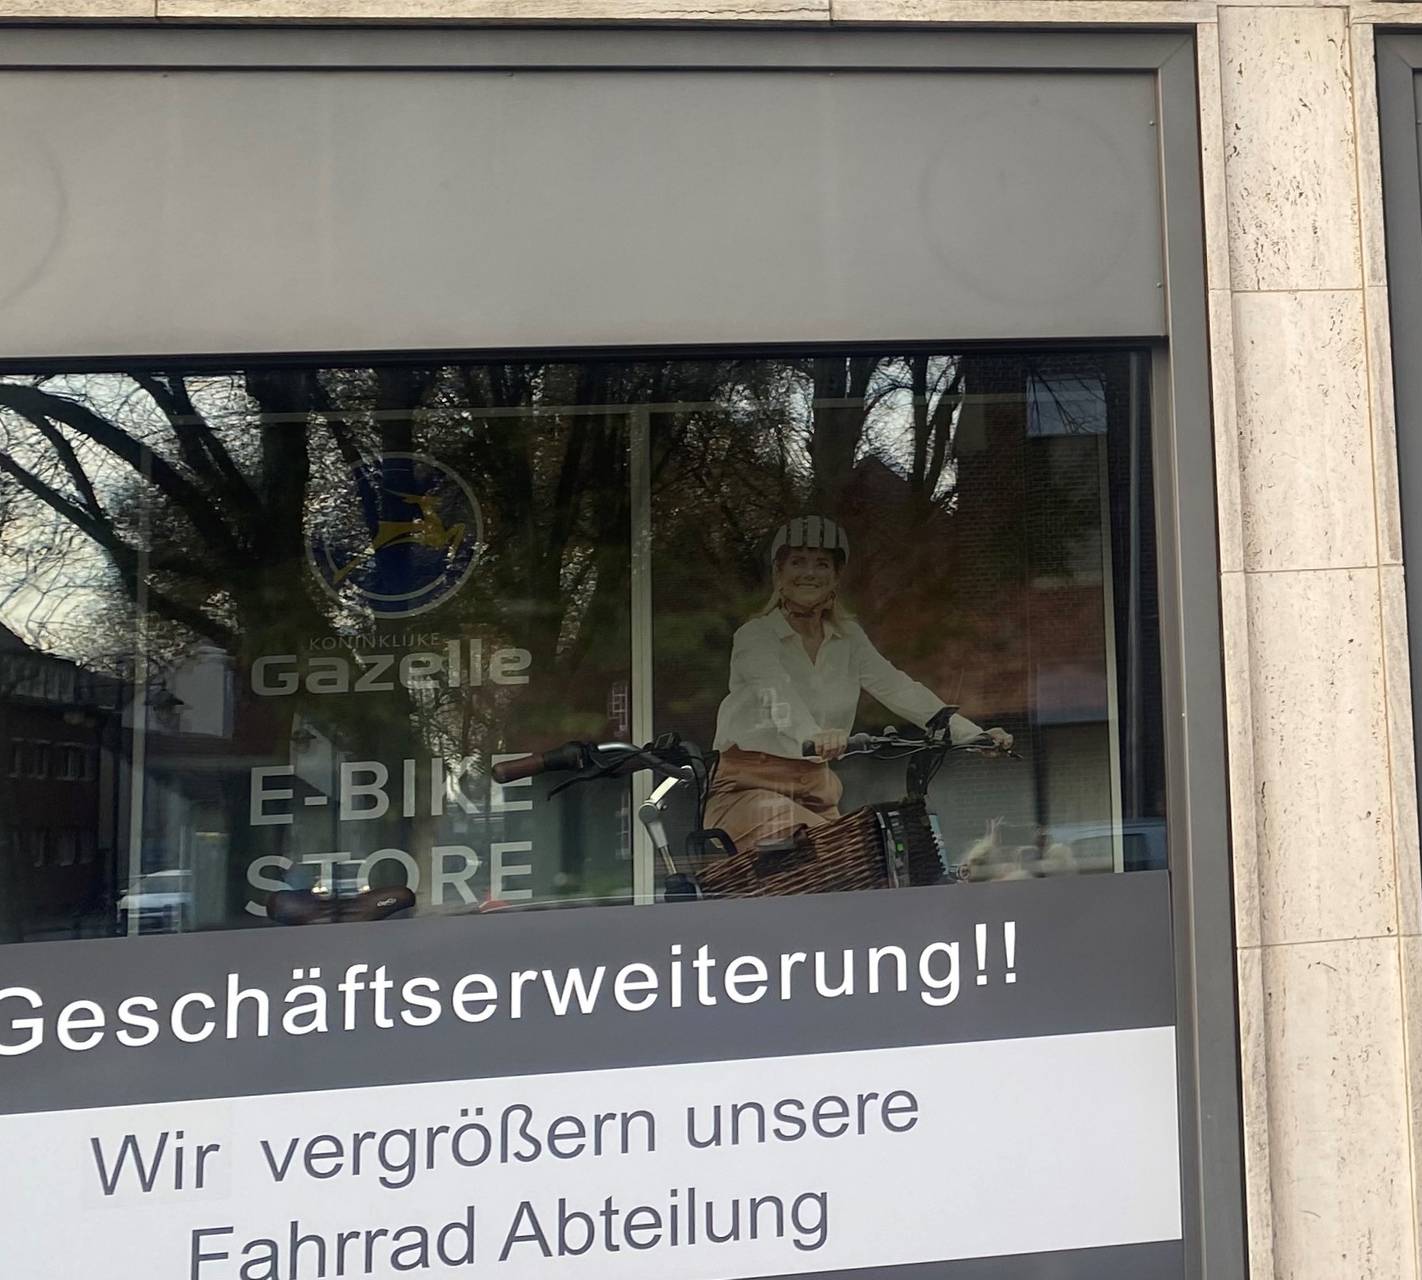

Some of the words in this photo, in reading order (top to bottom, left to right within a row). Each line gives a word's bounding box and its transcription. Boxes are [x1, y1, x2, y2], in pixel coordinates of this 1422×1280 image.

[250, 639, 533, 697] Gazelle
[309, 632, 441, 651] KONINKLIJKE
[249, 752, 534, 826] E-BIKE
[244, 840, 534, 919] STORE
[0, 921, 1017, 1057] Geschäftserweiterung!!
[90, 1129, 221, 1197] Wir
[259, 1103, 656, 1189] vergrößern
[685, 1087, 920, 1149] unsere
[189, 1205, 476, 1280] Fahrrad
[498, 1187, 829, 1262] Abteilung
